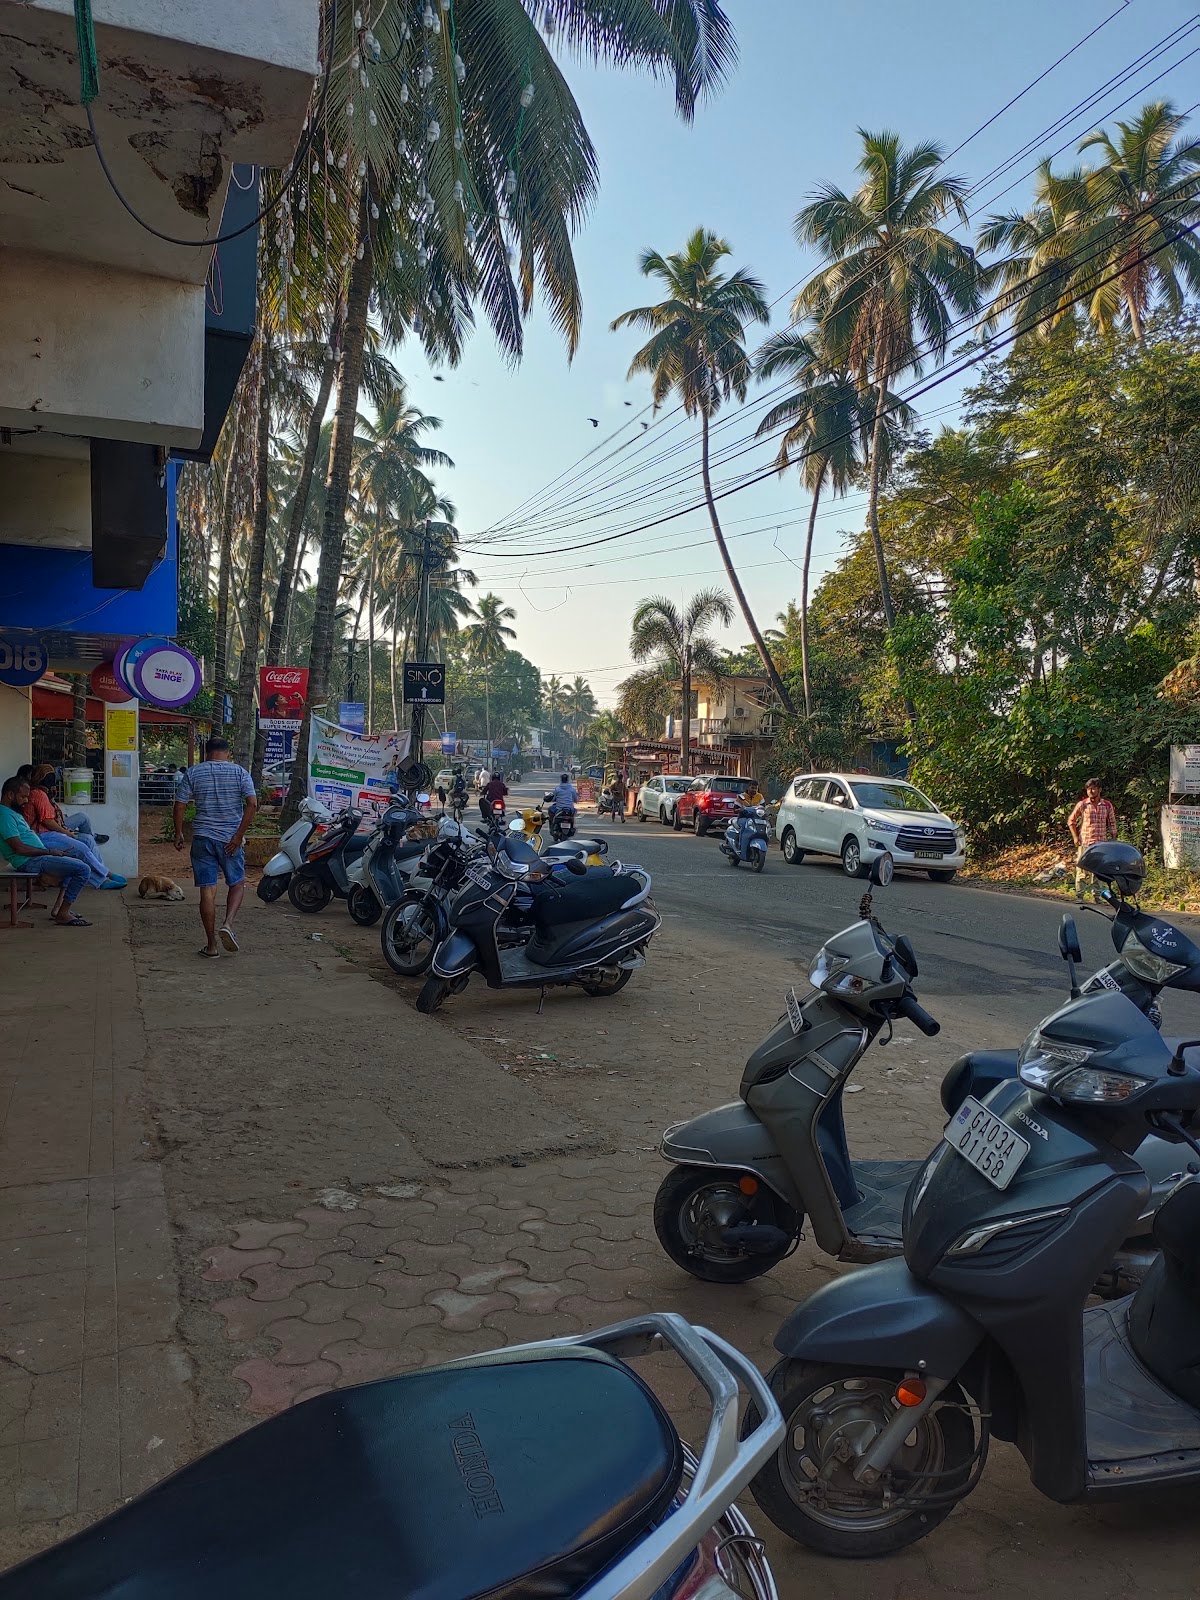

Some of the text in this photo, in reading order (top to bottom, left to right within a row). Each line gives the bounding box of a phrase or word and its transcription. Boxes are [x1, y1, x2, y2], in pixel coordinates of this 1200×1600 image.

[971, 1110, 1017, 1160] GA03A
[1014, 1108, 1049, 1141] HONDA
[958, 1130, 1005, 1178] 01158
[448, 1411, 505, 1520] HONDA
